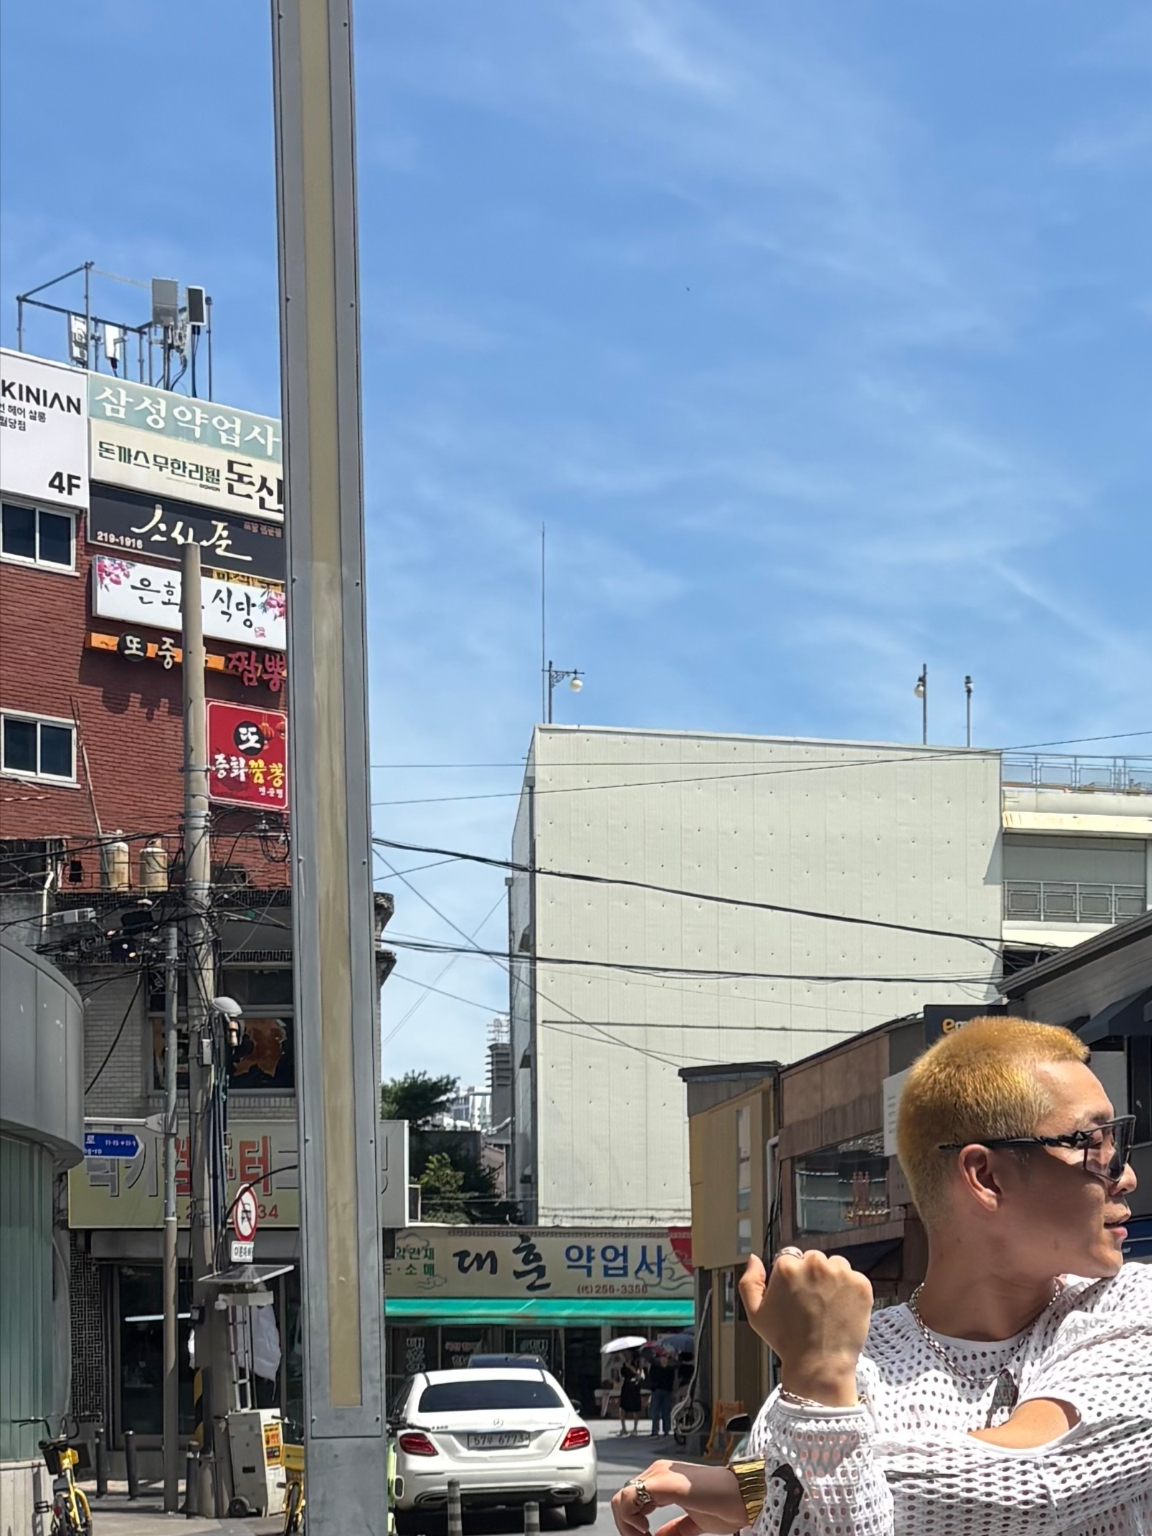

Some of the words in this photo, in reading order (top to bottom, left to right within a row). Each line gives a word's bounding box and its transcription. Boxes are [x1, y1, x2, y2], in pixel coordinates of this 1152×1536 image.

[8, 404, 26, 419] 헤어
[95, 386, 281, 457] 삼성약업사
[48, 471, 82, 496] 4F
[211, 587, 257, 629] 식당
[124, 635, 145, 656] 또
[238, 726, 262, 751] 또
[453, 1234, 552, 1292] 대훈
[564, 1244, 666, 1278] 약업사
